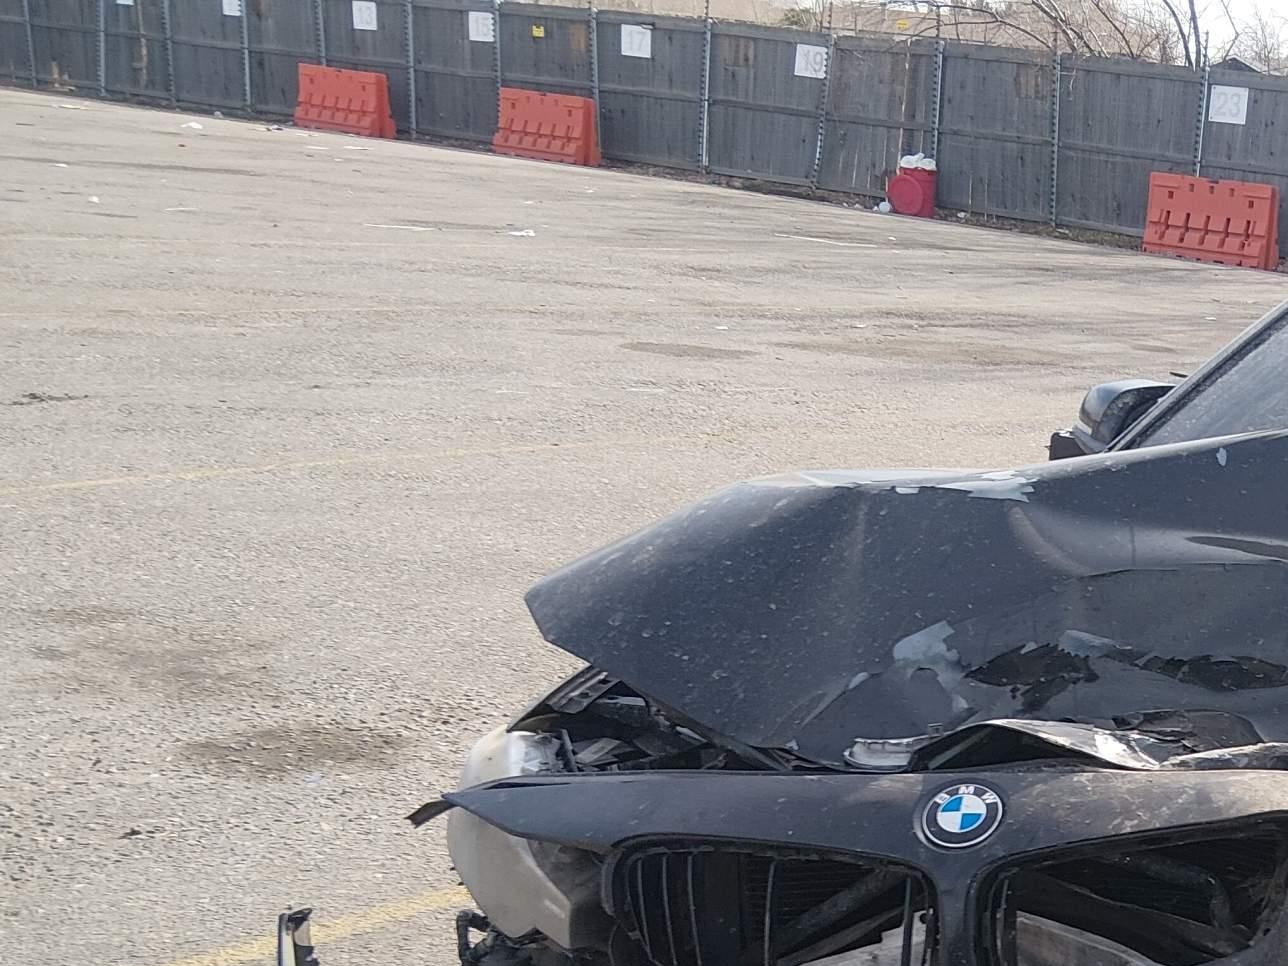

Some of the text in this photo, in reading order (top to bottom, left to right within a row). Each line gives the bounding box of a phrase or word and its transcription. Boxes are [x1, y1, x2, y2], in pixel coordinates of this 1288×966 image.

[629, 30, 646, 51] 17
[1215, 92, 1241, 118] 23
[934, 785, 998, 805] BMW
